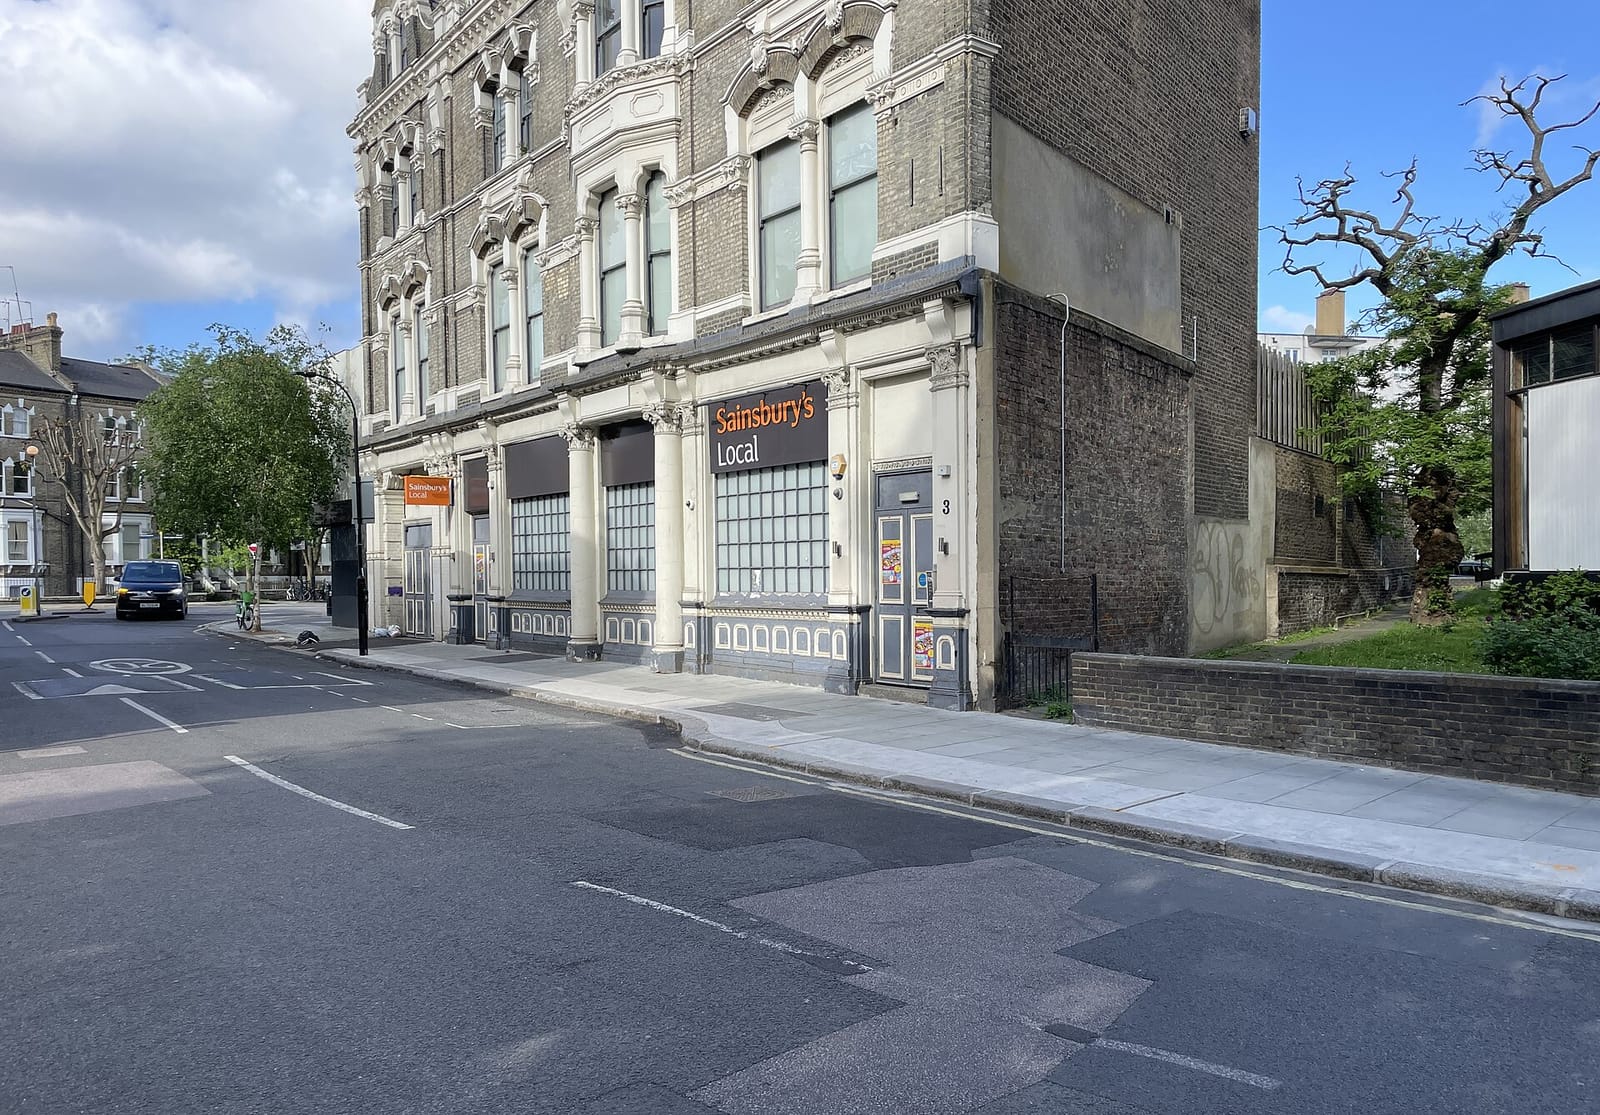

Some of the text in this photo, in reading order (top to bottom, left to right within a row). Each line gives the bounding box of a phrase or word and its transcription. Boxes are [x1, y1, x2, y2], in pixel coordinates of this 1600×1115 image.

[716, 391, 814, 434] Sainsbury's
[718, 435, 759, 467] Local
[408, 483, 447, 492] Sainsbury's
[942, 499, 951, 515] 3
